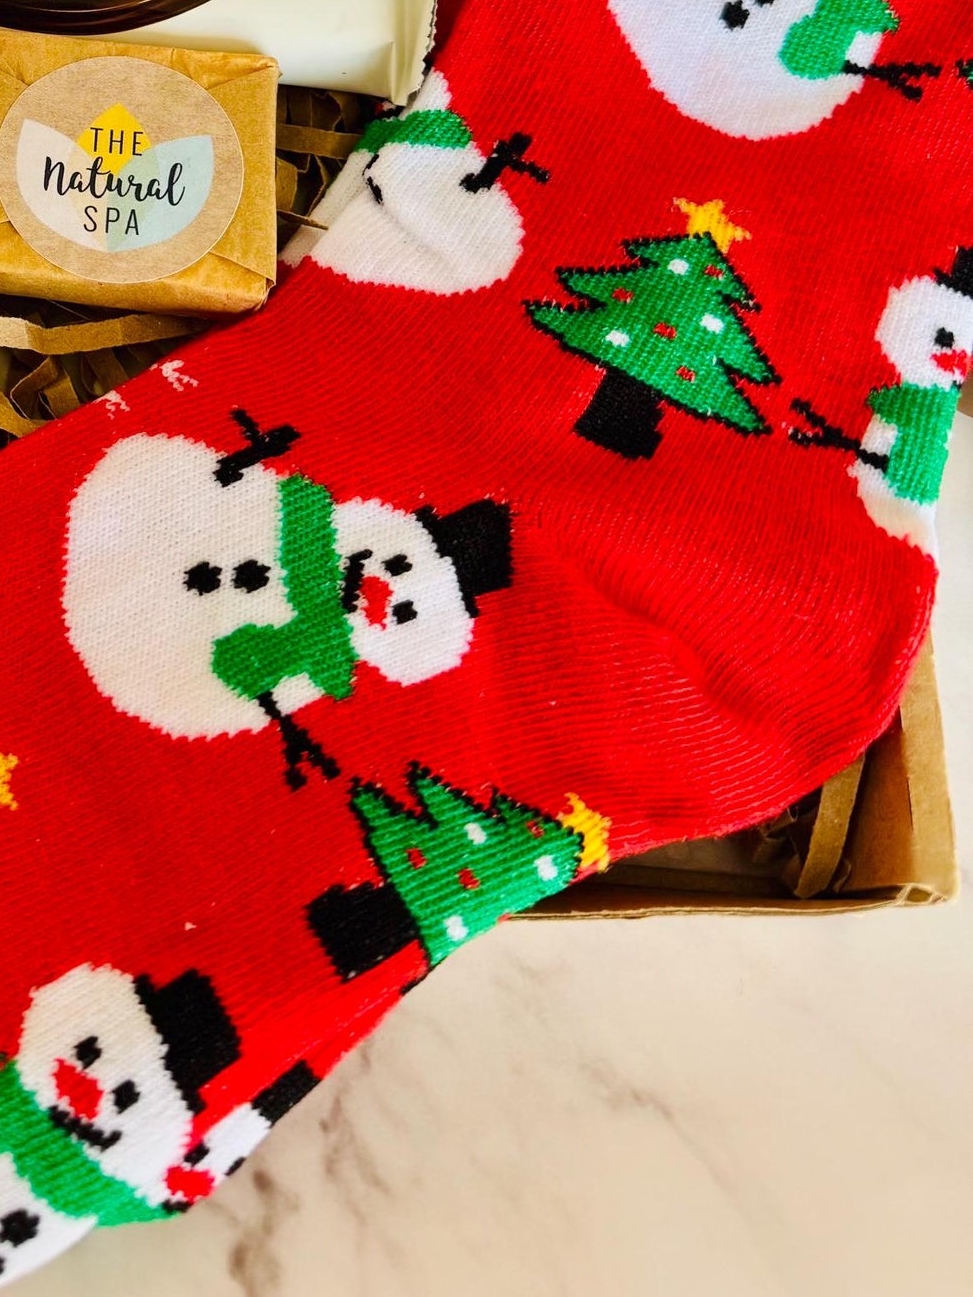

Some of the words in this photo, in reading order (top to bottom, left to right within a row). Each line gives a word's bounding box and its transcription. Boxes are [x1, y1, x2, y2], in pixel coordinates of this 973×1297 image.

[89, 126, 145, 157] THE
[43, 155, 187, 207] Natural
[83, 205, 141, 237] SPA
